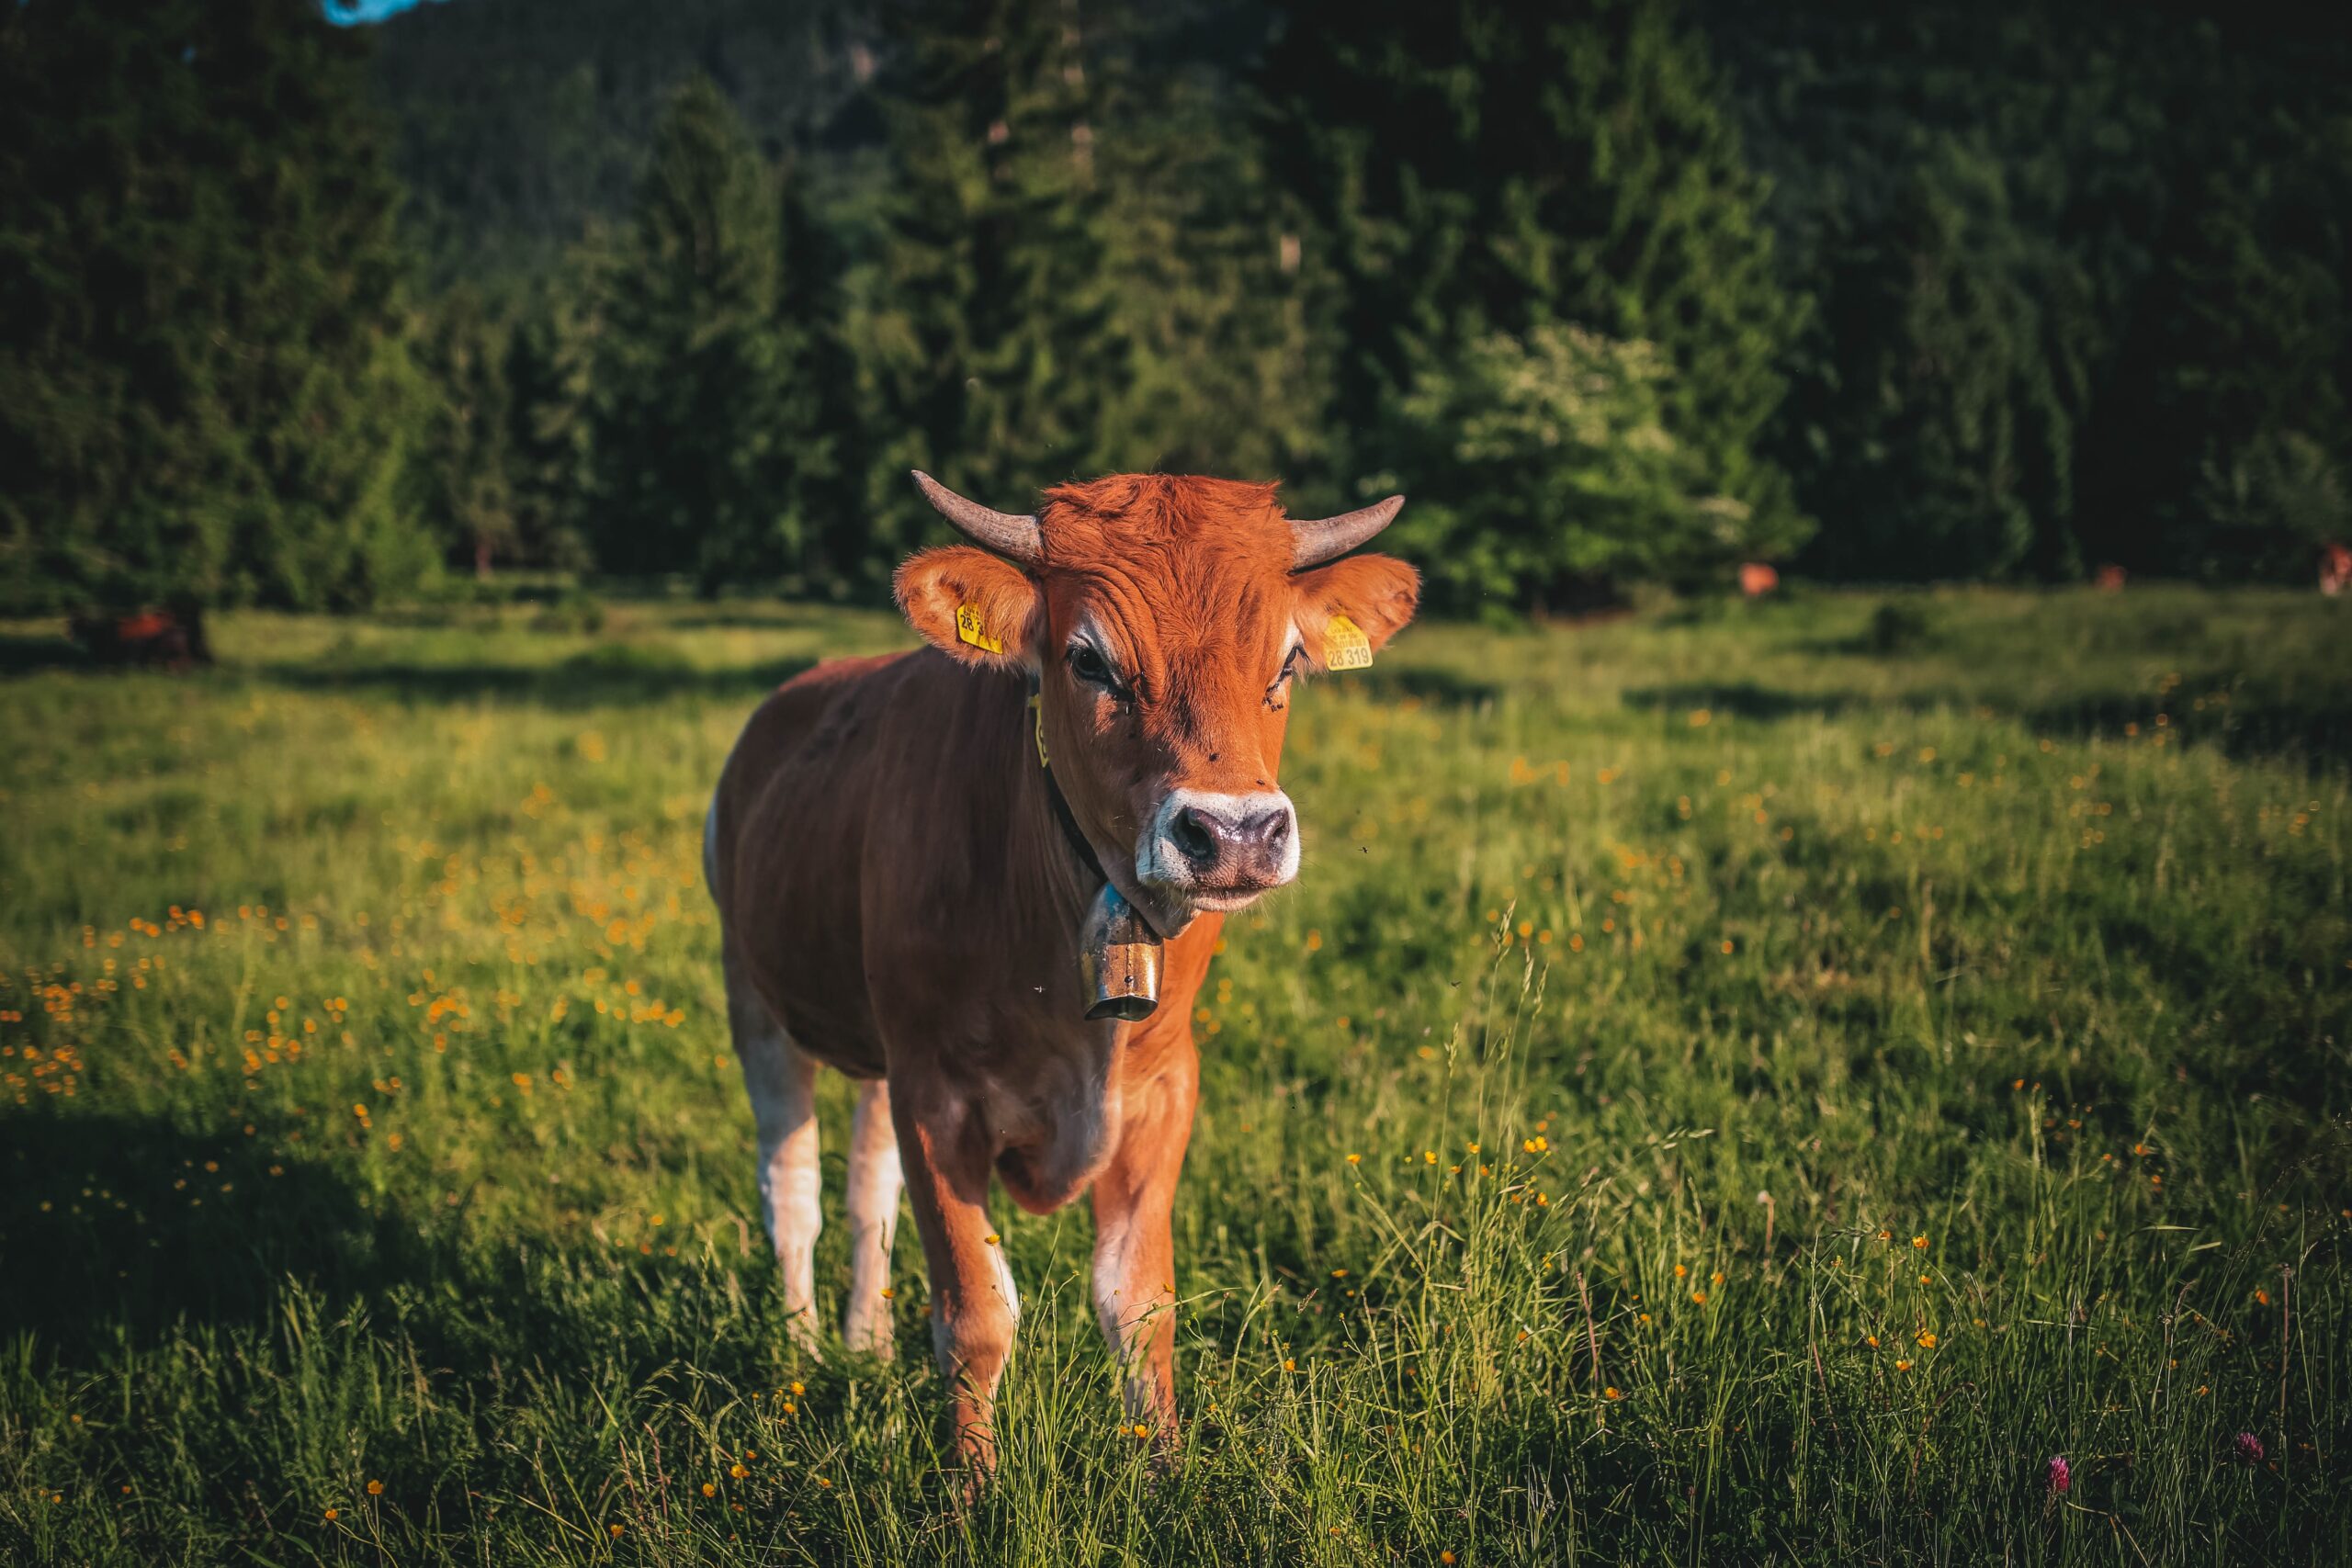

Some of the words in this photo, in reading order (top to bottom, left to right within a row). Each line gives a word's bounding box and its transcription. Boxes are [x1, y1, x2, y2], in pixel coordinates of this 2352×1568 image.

[960, 615, 974, 632] 28
[1329, 650, 1344, 667] 28
[1346, 648, 1369, 666] 319
